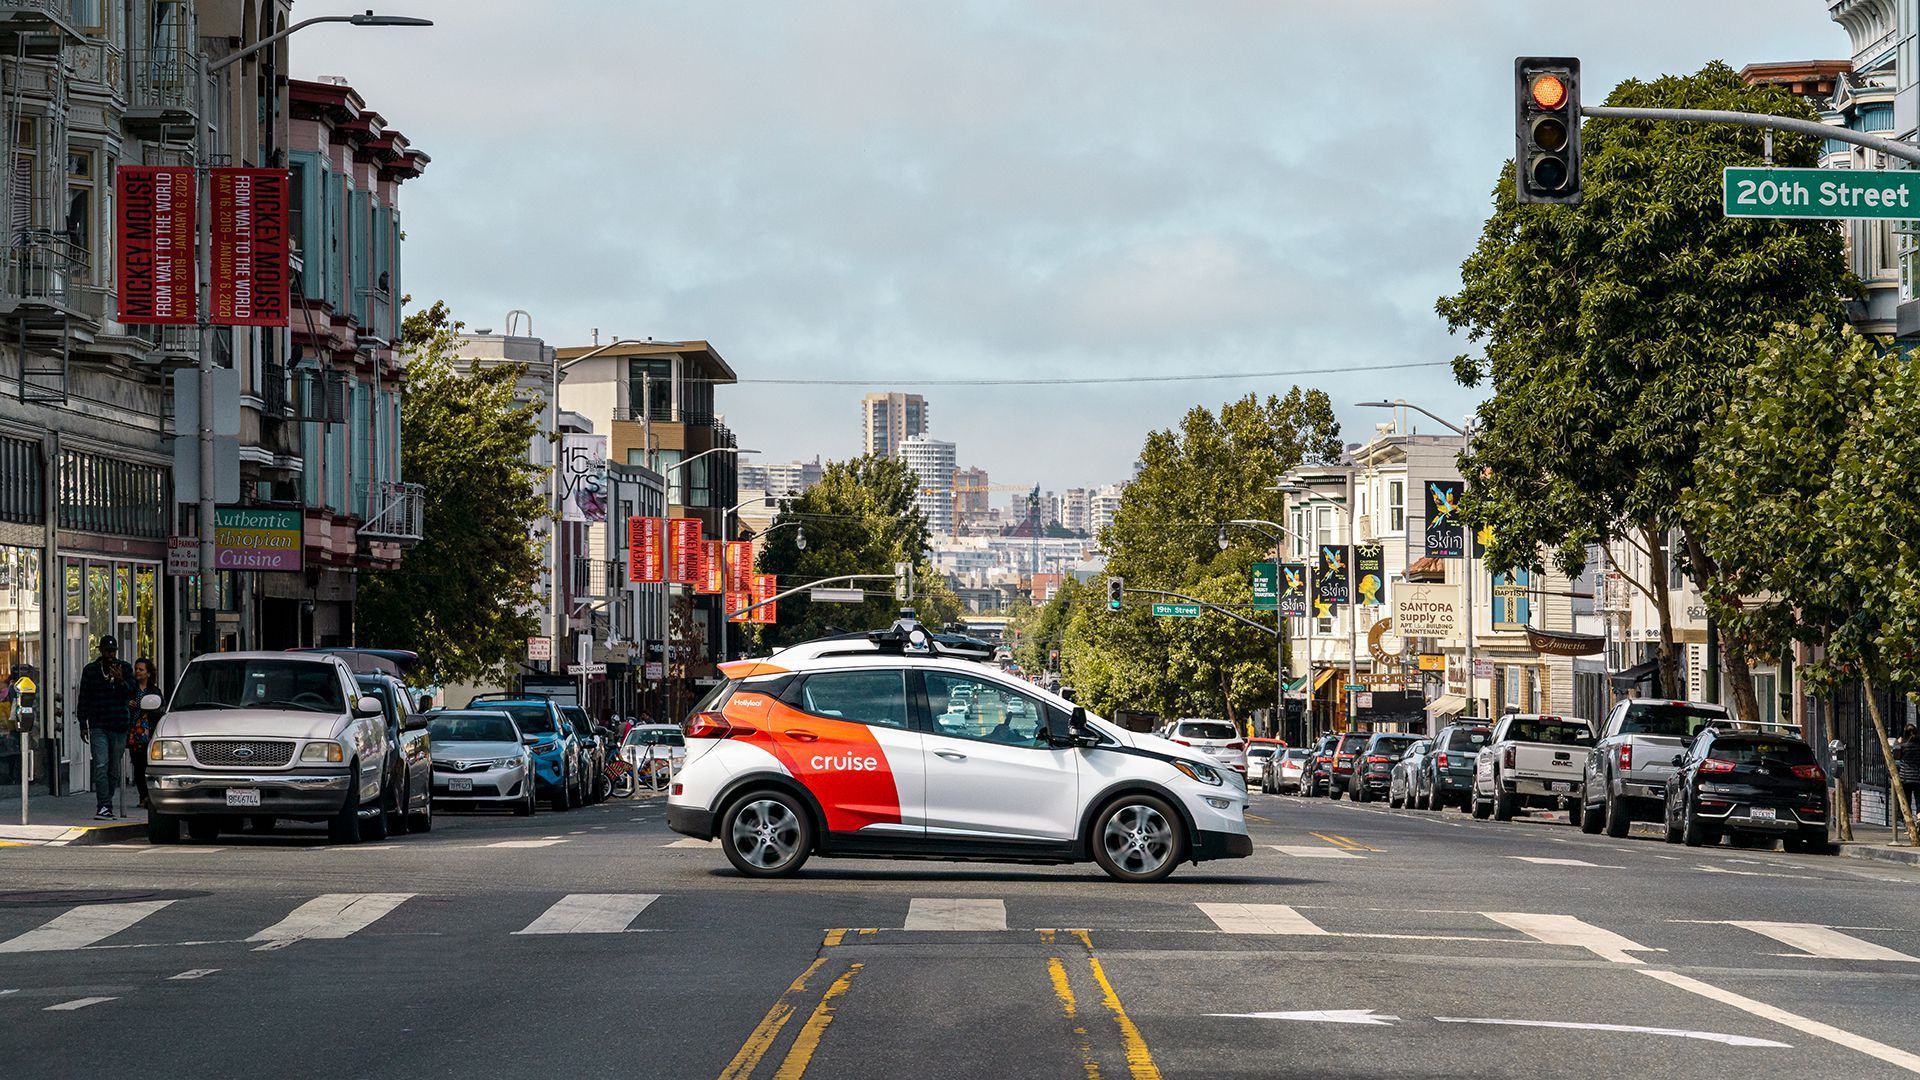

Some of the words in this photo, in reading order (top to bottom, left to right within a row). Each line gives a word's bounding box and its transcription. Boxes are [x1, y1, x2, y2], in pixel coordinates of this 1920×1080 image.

[156, 172, 172, 213] WORLD
[175, 173, 188, 198] 2020
[219, 175, 231, 195] MAY
[235, 175, 250, 207] FROM
[1736, 180, 1809, 206] 20th
[1818, 181, 1910, 208] Street
[126, 171, 153, 240] MOUSE
[254, 176, 280, 247] MICKEY
[156, 214, 171, 236] THE
[235, 209, 250, 240] WALT
[156, 237, 171, 253] TO
[235, 240, 250, 254] TO
[156, 255, 171, 283] WALT
[235, 255, 250, 277] THE
[126, 245, 153, 317] MICKEY
[254, 251, 280, 319] MOUSE
[156, 287, 171, 317] FROM
[175, 298, 188, 318] MAY
[219, 294, 231, 318] 2020
[235, 280, 250, 319] WORLD
[562, 446, 589, 474] 15
[562, 474, 600, 501] yrs
[214, 511, 290, 528] Authentic
[214, 530, 292, 549] thiopian
[633, 519, 645, 548] MOUSE
[686, 522, 698, 552] MICKEY
[1427, 530, 1463, 549] skin
[220, 549, 281, 567] Cuisine
[633, 549, 645, 580] MICKEY
[686, 552, 698, 581] MOUSE
[1320, 583, 1348, 598] skin
[1494, 589, 1526, 597] BAPTIST
[1174, 606, 1197, 614] Street
[1281, 598, 1306, 611] skin
[1400, 602, 1453, 613] SANTORA
[1400, 612, 1436, 623] supply
[1440, 614, 1455, 622] co.
[1404, 628, 1449, 636] MAINTENANCE
[1535, 638, 1586, 651] Amnesia
[1346, 675, 1378, 683] IISH
[733, 699, 763, 708] Hollyleaf
[811, 751, 878, 771] cruise
[1552, 760, 1573, 768] GMC
